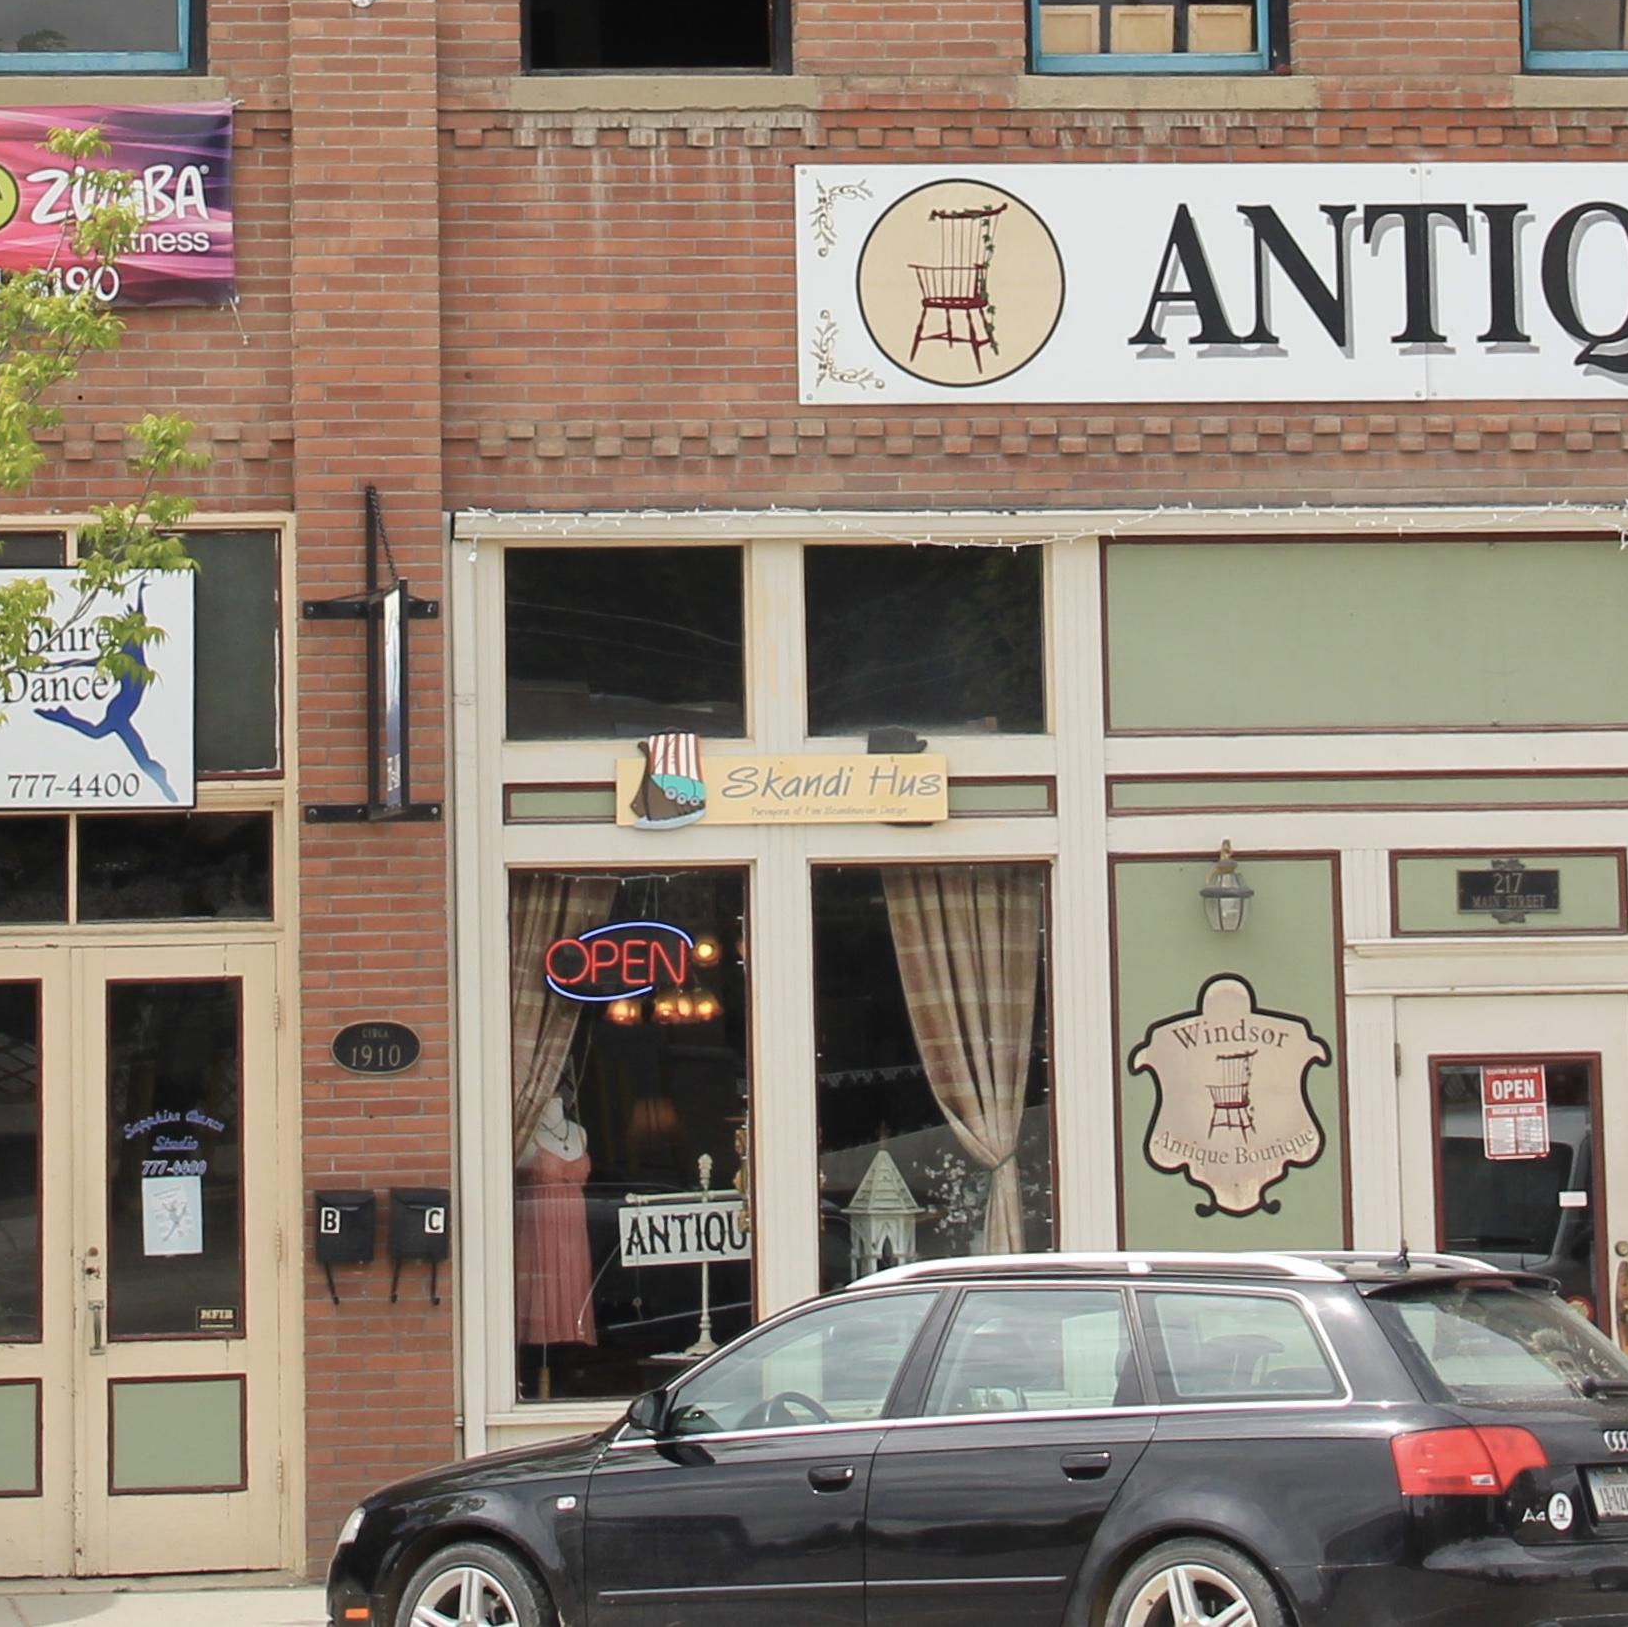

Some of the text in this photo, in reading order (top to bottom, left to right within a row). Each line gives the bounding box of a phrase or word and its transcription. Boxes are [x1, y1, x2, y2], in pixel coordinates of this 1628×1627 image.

[113, 227, 210, 253] tness
[2, 671, 111, 703] Dance
[722, 765, 942, 801] Skandi Hus
[1493, 873, 1522, 893] 217
[1472, 895, 1546, 908] MAIN STREET
[545, 938, 686, 984] OPEN
[362, 1028, 389, 1039] CIRCA
[1171, 1019, 1289, 1050] Windsor
[351, 1044, 401, 1067] 1910
[1492, 1079, 1535, 1100] OPEN
[124, 1109, 180, 1139] Sapphire
[152, 1135, 199, 1152] Studio
[1155, 1128, 1315, 1166] Antique Boutique
[324, 1210, 338, 1231] B
[428, 1210, 442, 1231] C
[1522, 1508, 1546, 1522] A4
